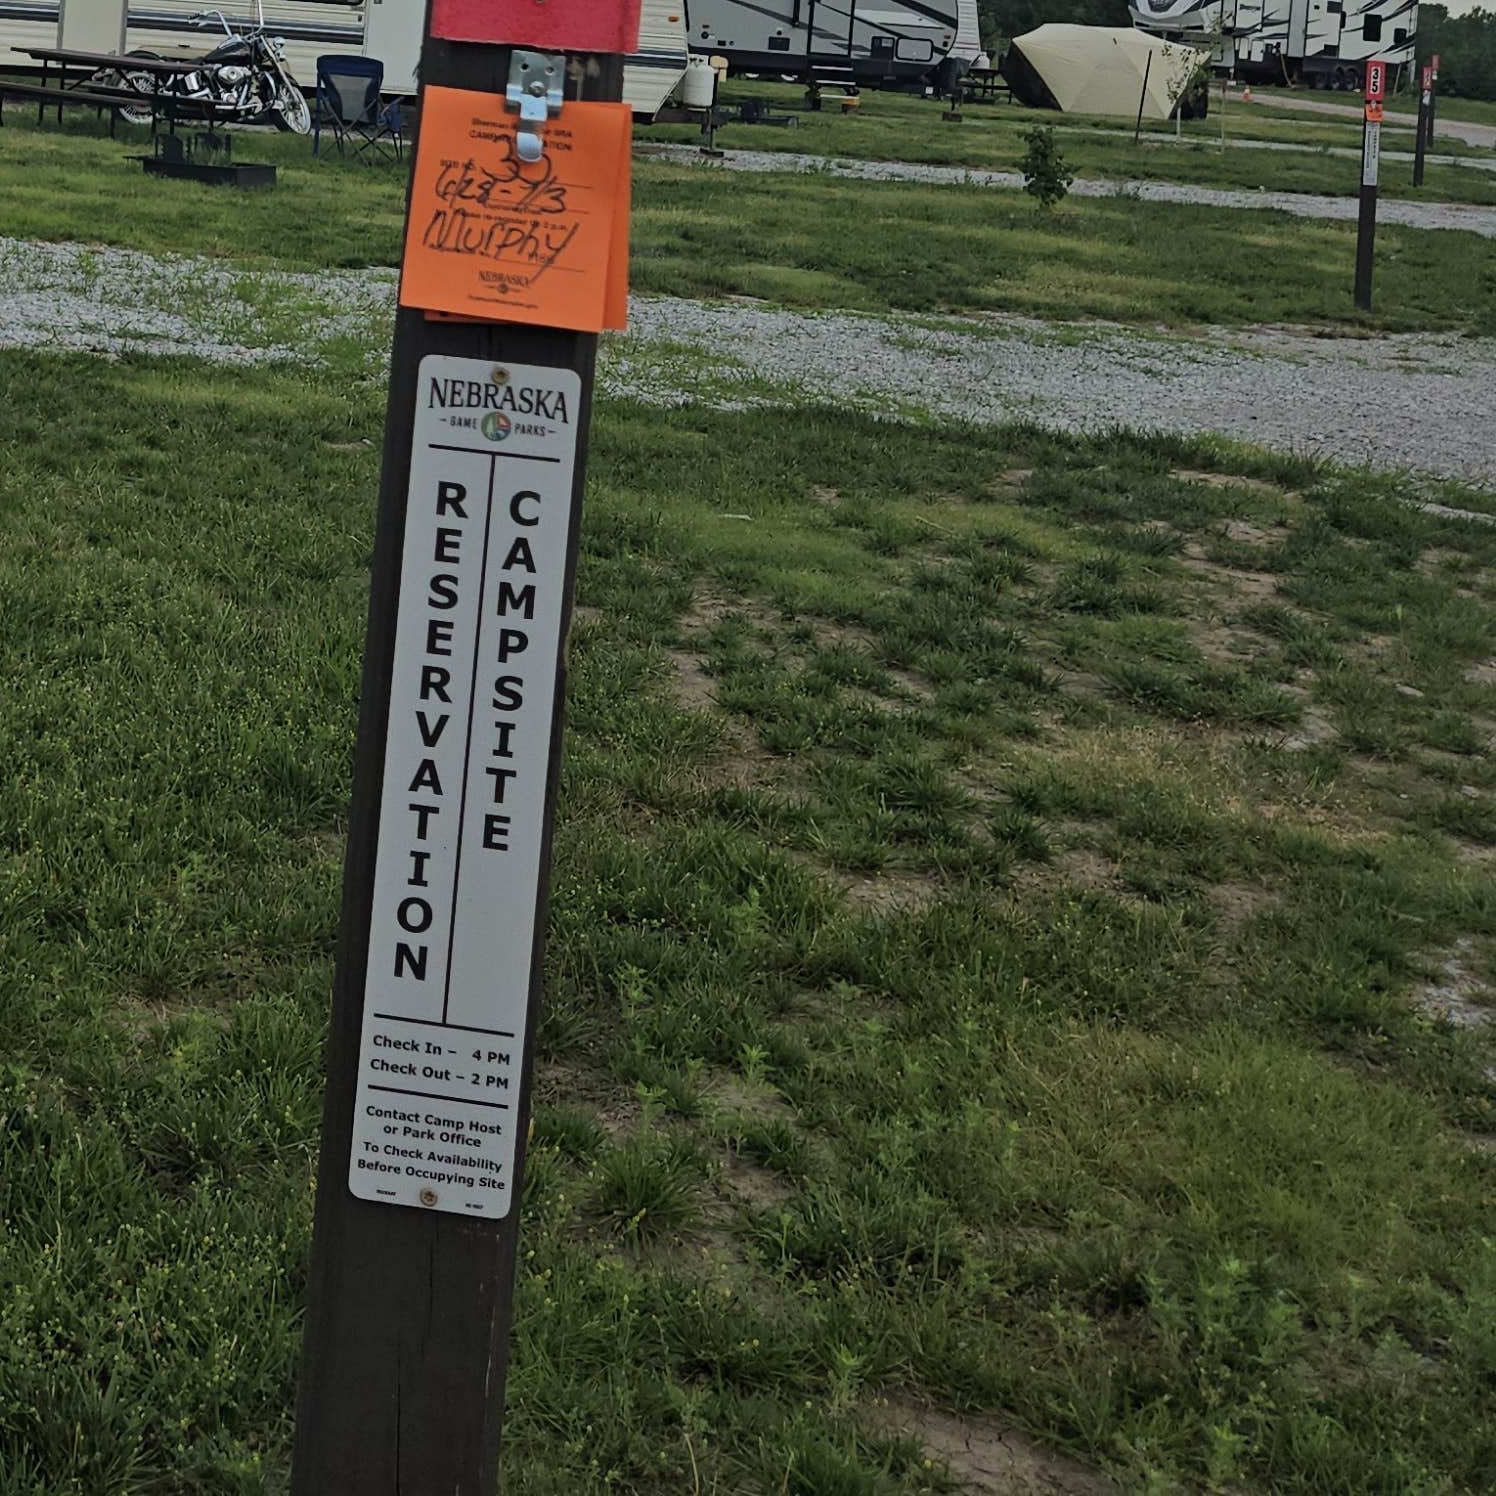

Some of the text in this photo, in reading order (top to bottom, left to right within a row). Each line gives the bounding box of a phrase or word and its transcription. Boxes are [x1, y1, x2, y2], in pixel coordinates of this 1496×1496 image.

[422, 207, 580, 284] Murphy
[428, 377, 569, 424] NEBRASKA
[450, 415, 546, 437] GAME PARKS
[483, 490, 541, 851] CAMPSITE
[394, 480, 468, 981] RESERVATION
[373, 1034, 420, 1053] Check
[425, 1042, 442, 1056] In
[472, 1049, 482, 1061] 4
[487, 1051, 510, 1066] PM
[370, 1058, 417, 1076] Check
[422, 1066, 451, 1081] Out
[471, 1073, 481, 1085] 2
[486, 1075, 509, 1090] PM
[366, 1105, 502, 1135] Contact Camp Host
[383, 1124, 482, 1148] or Park Office
[363, 1141, 502, 1173] To Check Availability
[357, 1158, 505, 1190] Before Occupying Site
